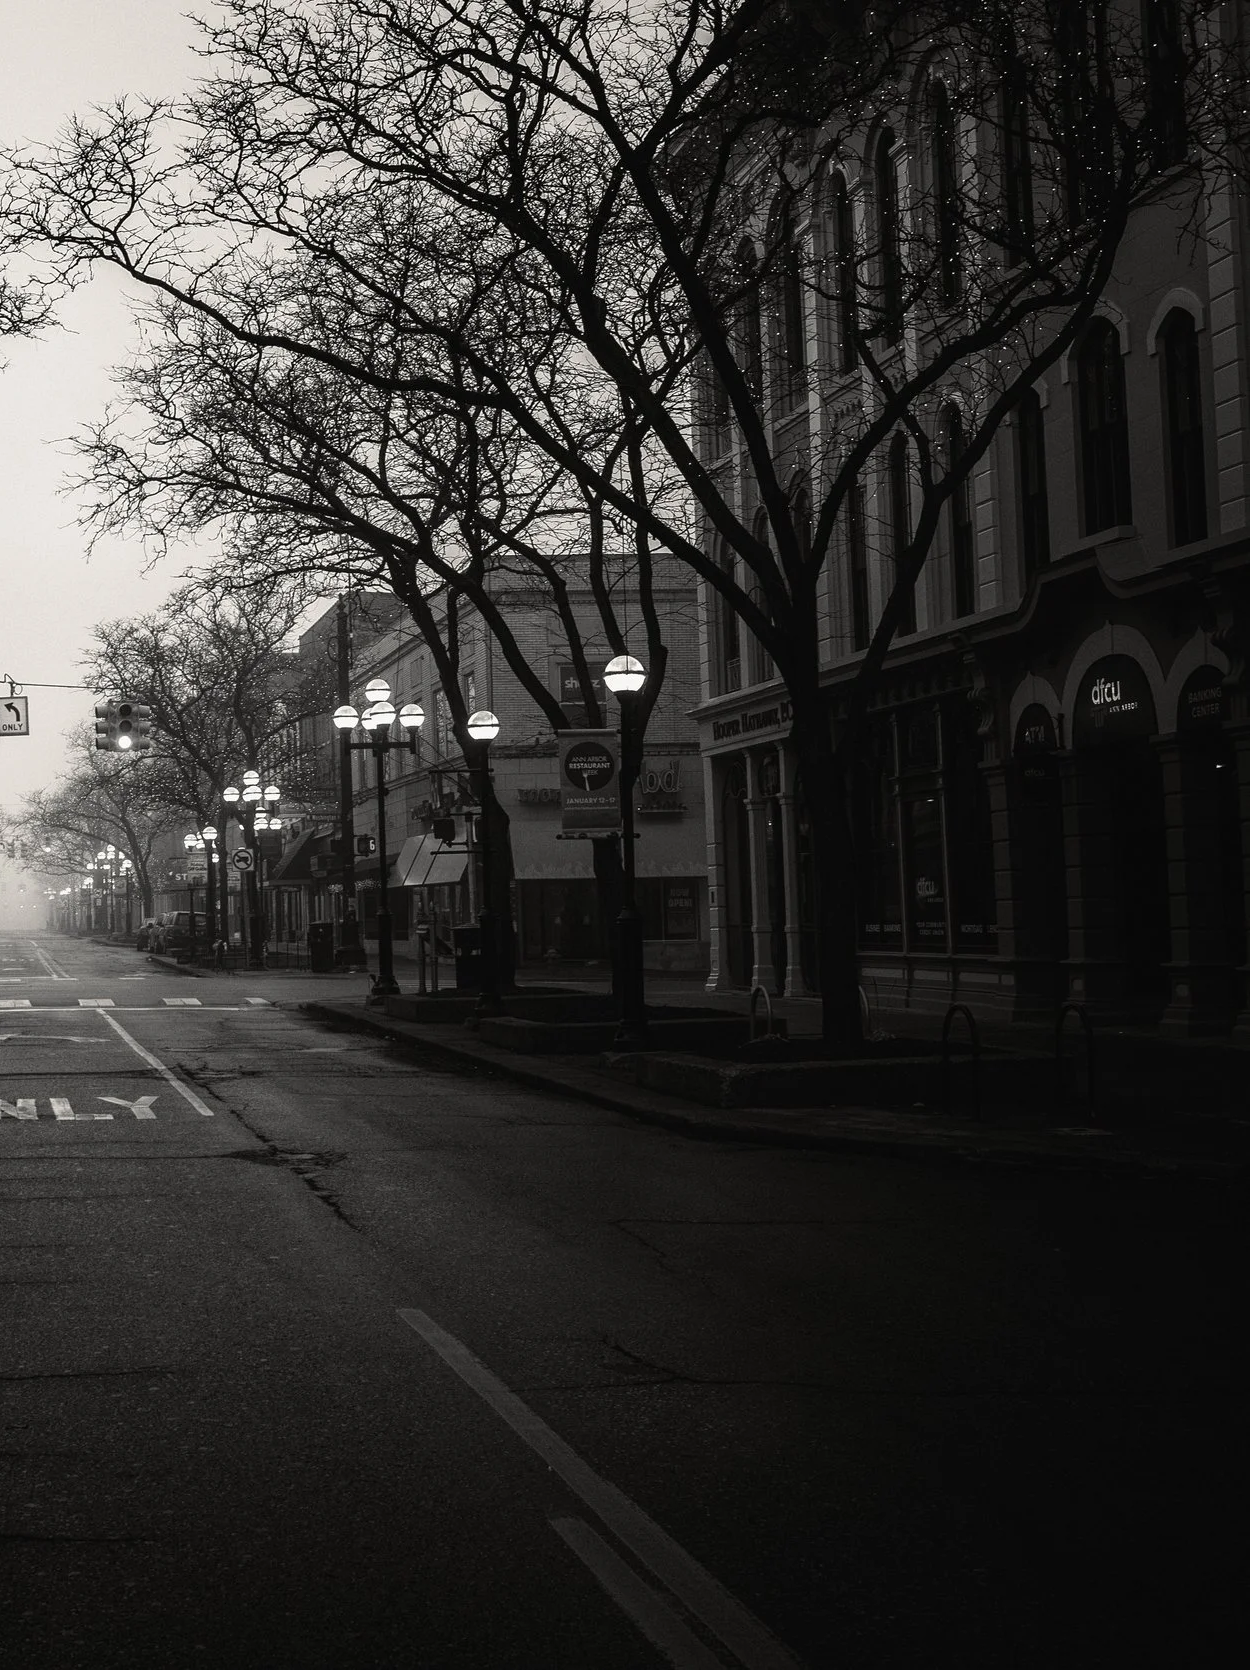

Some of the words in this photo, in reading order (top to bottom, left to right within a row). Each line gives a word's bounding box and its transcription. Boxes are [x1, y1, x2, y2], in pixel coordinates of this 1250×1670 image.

[1091, 678, 1120, 704] dfcu
[1188, 686, 1222, 704] BANKING
[1191, 703, 1220, 718] CENTER
[2, 723, 23, 731] ONLY
[368, 839, 376, 851] 6
